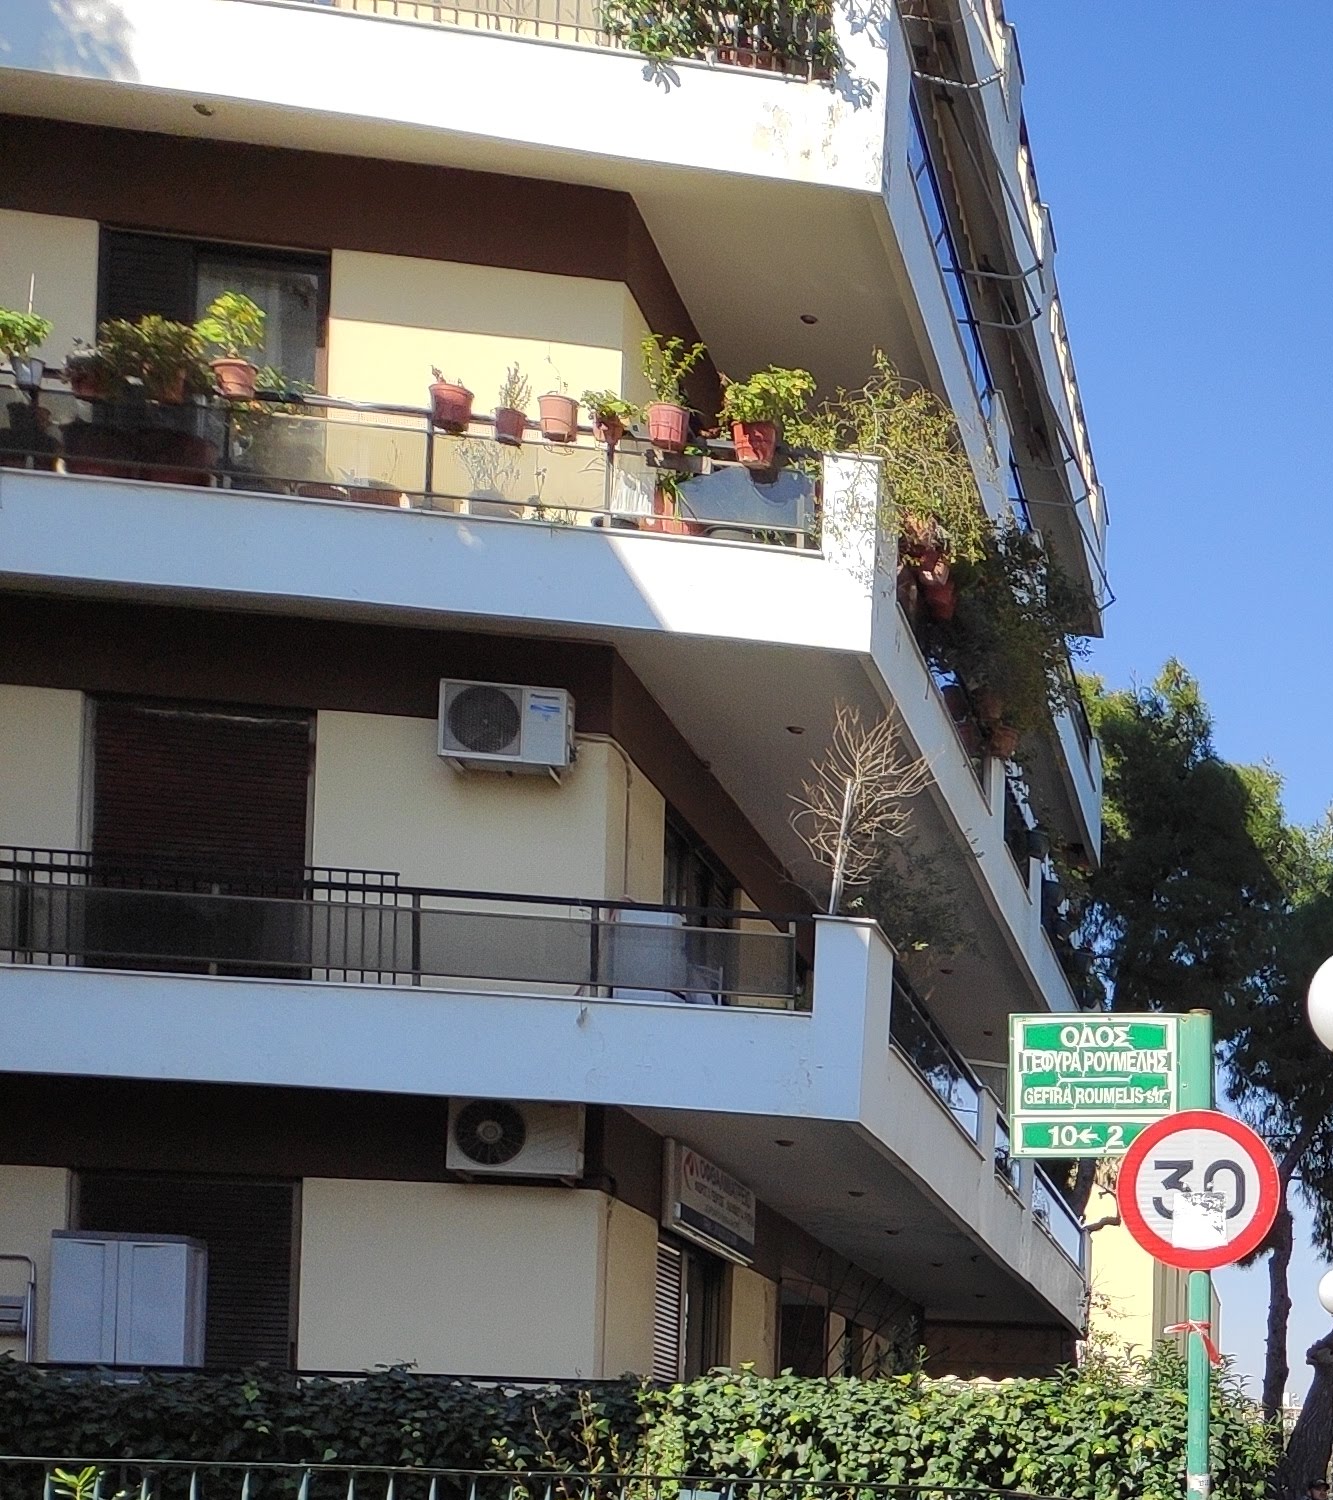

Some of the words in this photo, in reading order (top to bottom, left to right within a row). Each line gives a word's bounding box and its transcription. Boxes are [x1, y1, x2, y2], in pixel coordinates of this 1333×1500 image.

[1060, 1025, 1133, 1048] ΟΔΟΣ
[1023, 1051, 1082, 1072] ΓΕΦΥΡΑ
[1083, 1051, 1169, 1072] ΡΟΥΜΕΛΗΣ
[1023, 1086, 1074, 1104] GEFIRA
[1075, 1086, 1143, 1104] ROUMELIS
[1049, 1125, 1077, 1146] 10
[1107, 1125, 1124, 1146] 2
[1152, 1159, 1246, 1221] 30
